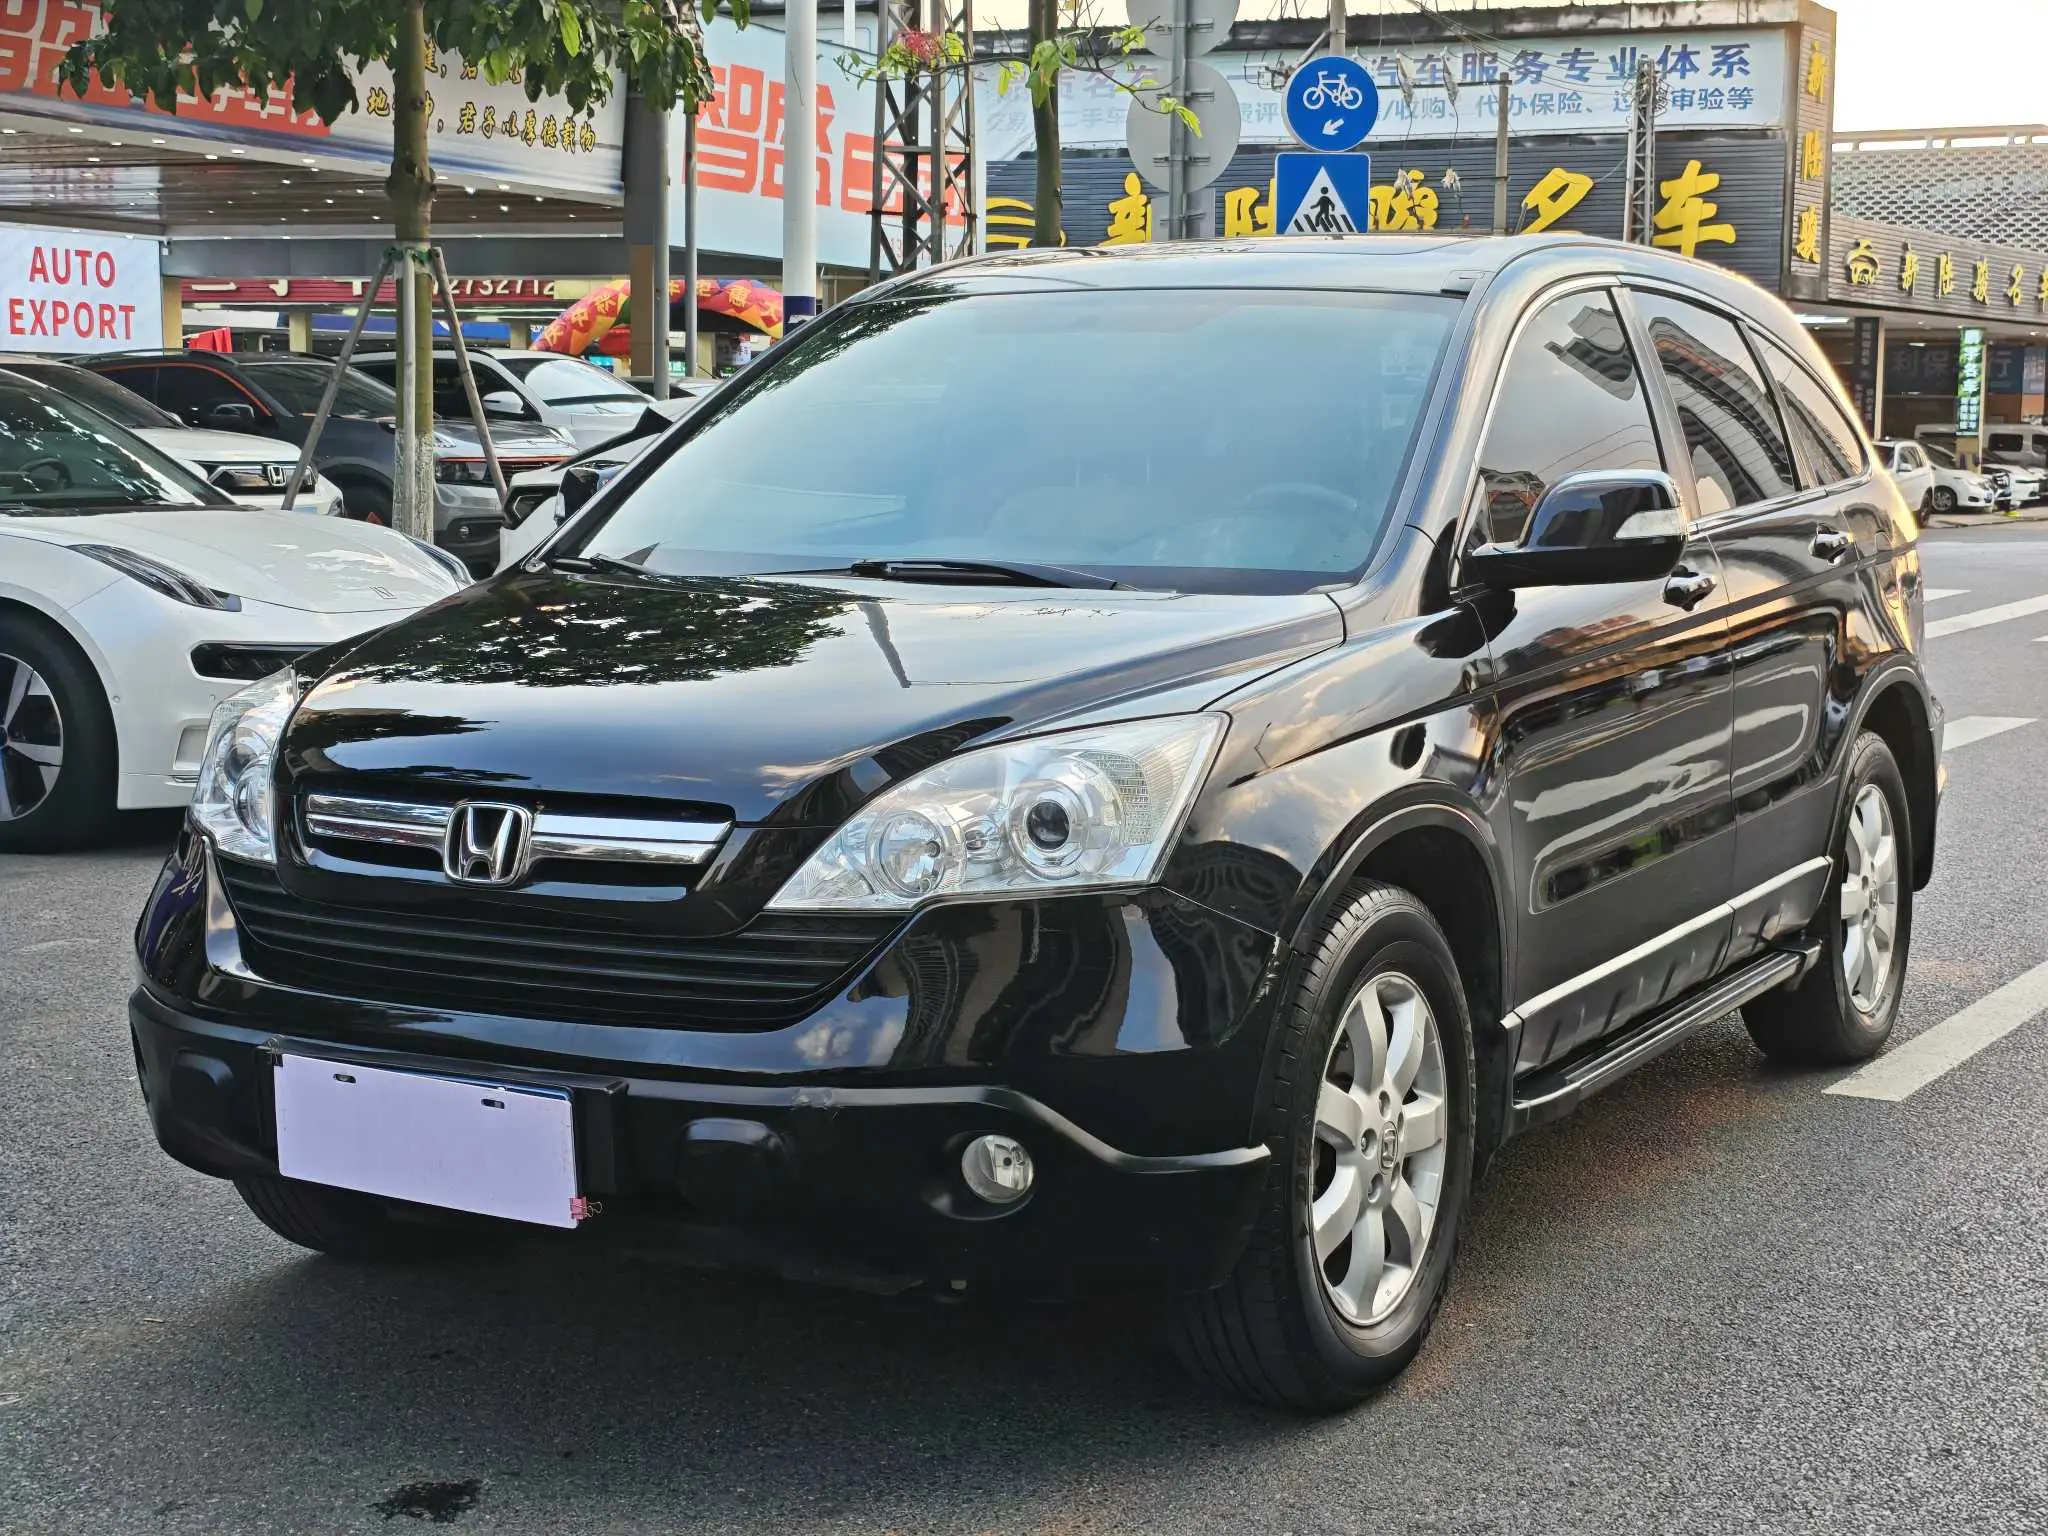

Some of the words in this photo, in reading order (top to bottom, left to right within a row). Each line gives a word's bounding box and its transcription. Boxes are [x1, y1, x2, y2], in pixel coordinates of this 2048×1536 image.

[366, 86, 597, 155] 地，君子以厚德载物
[29, 246, 116, 288] AUTO
[9, 298, 136, 340] EXPORT
